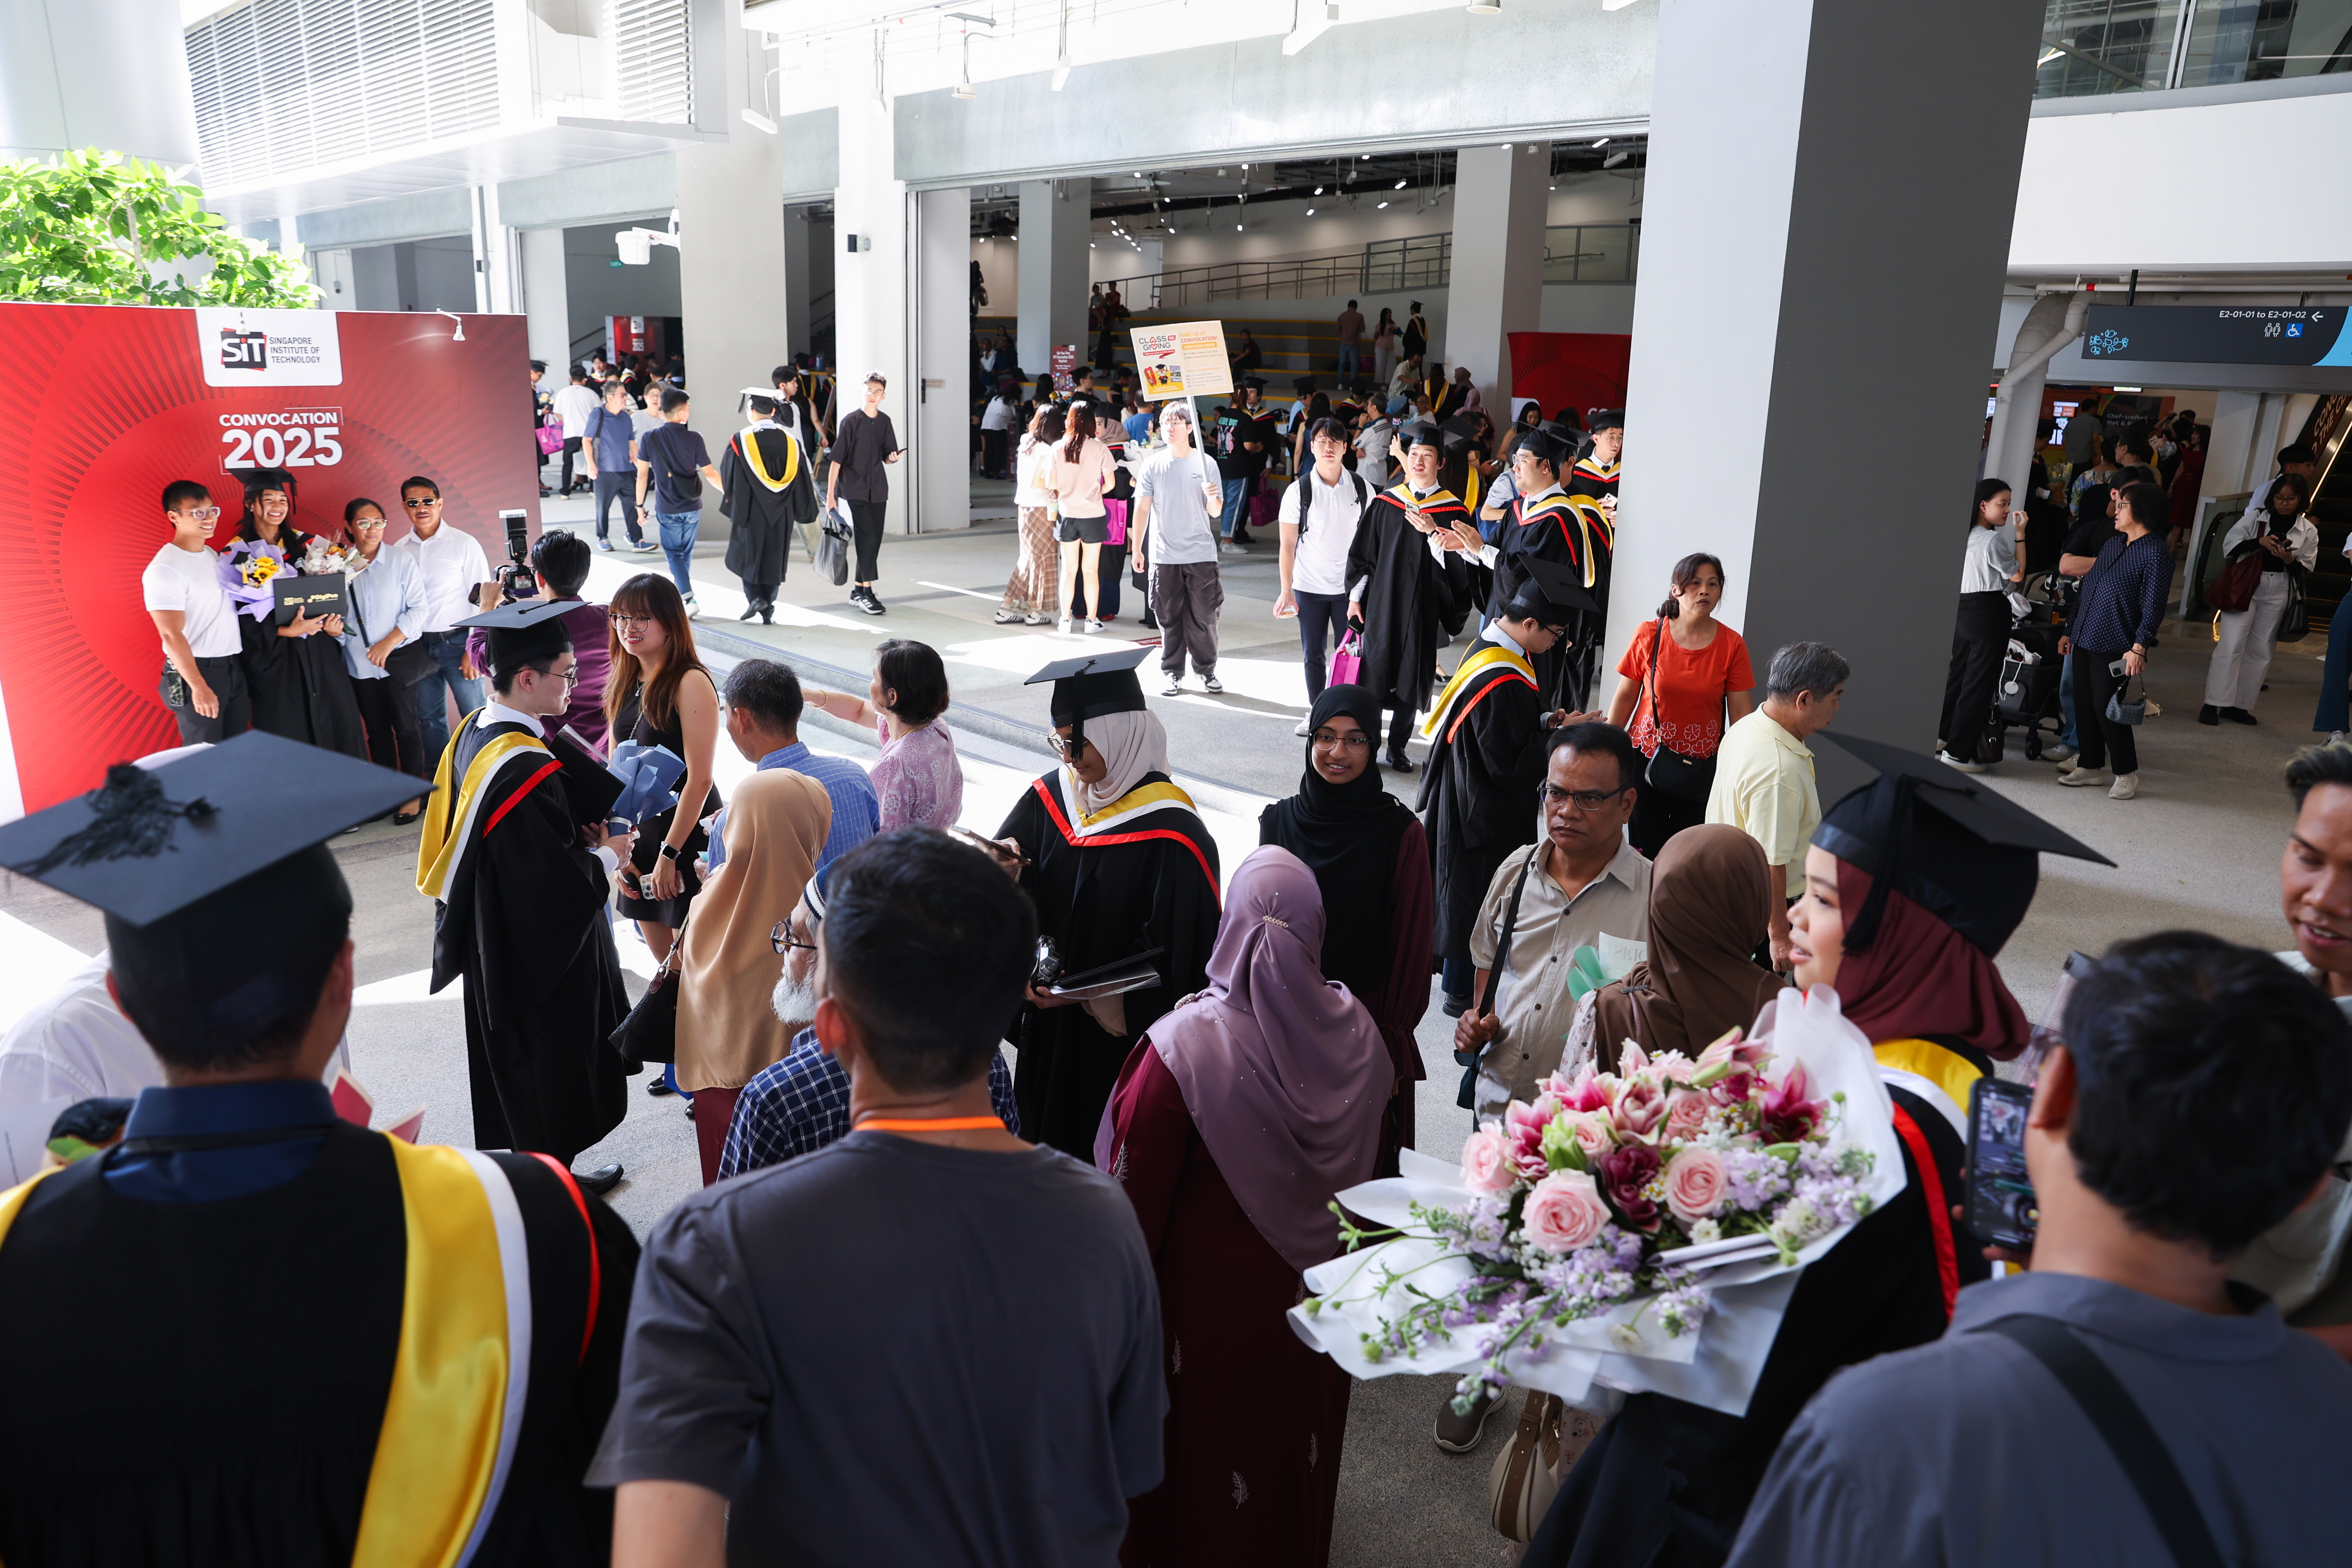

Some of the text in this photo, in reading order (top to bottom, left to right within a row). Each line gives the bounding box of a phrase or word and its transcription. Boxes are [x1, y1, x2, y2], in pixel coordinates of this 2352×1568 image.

[1139, 336, 1167, 344] CLASS
[219, 412, 338, 426] CONVOCATION
[2319, 408, 2334, 445] THE
[221, 426, 343, 469] 2025
